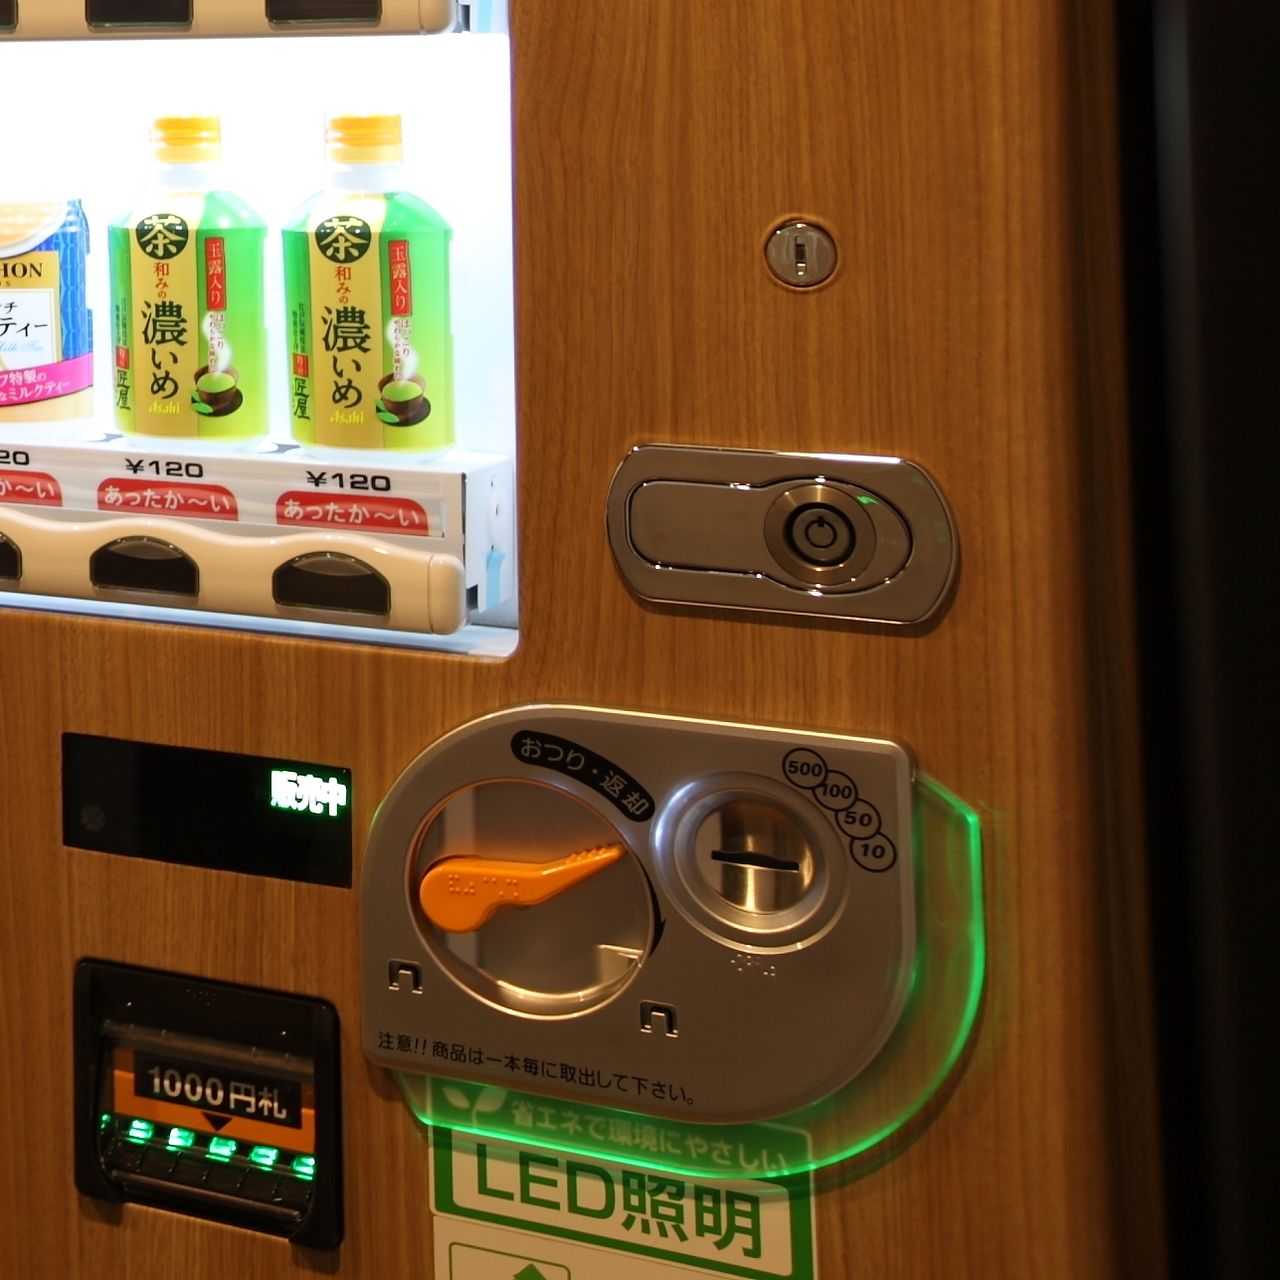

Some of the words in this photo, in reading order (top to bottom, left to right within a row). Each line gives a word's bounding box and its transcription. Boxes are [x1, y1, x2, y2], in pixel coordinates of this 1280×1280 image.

[139, 215, 186, 259] 茶
[318, 217, 369, 260] 茶
[153, 261, 170, 299] 和みの
[208, 239, 224, 307] 玉露入り
[334, 265, 352, 305] 和みの
[392, 242, 409, 312] 玉露入り
[141, 300, 188, 401] 濃いめ
[321, 306, 373, 410] 濃いめ
[329, 410, 364, 425] Asahi
[125, 459, 204, 478] ¥120
[306, 470, 391, 491] ¥120
[519, 735, 651, 818] おつり・返却
[789, 760, 823, 778] 500
[270, 769, 348, 817] 販売中
[821, 783, 855, 802] 100
[844, 812, 873, 829] 50
[859, 842, 887, 861] 10
[377, 1031, 428, 1057] 注意!!
[431, 1040, 696, 1107] 商品は一本毎に取出して下さい。
[149, 1065, 288, 1120] 1000円札
[510, 1097, 788, 1175] 省エネで環境にやさしい
[475, 1141, 763, 1260] LED照明
